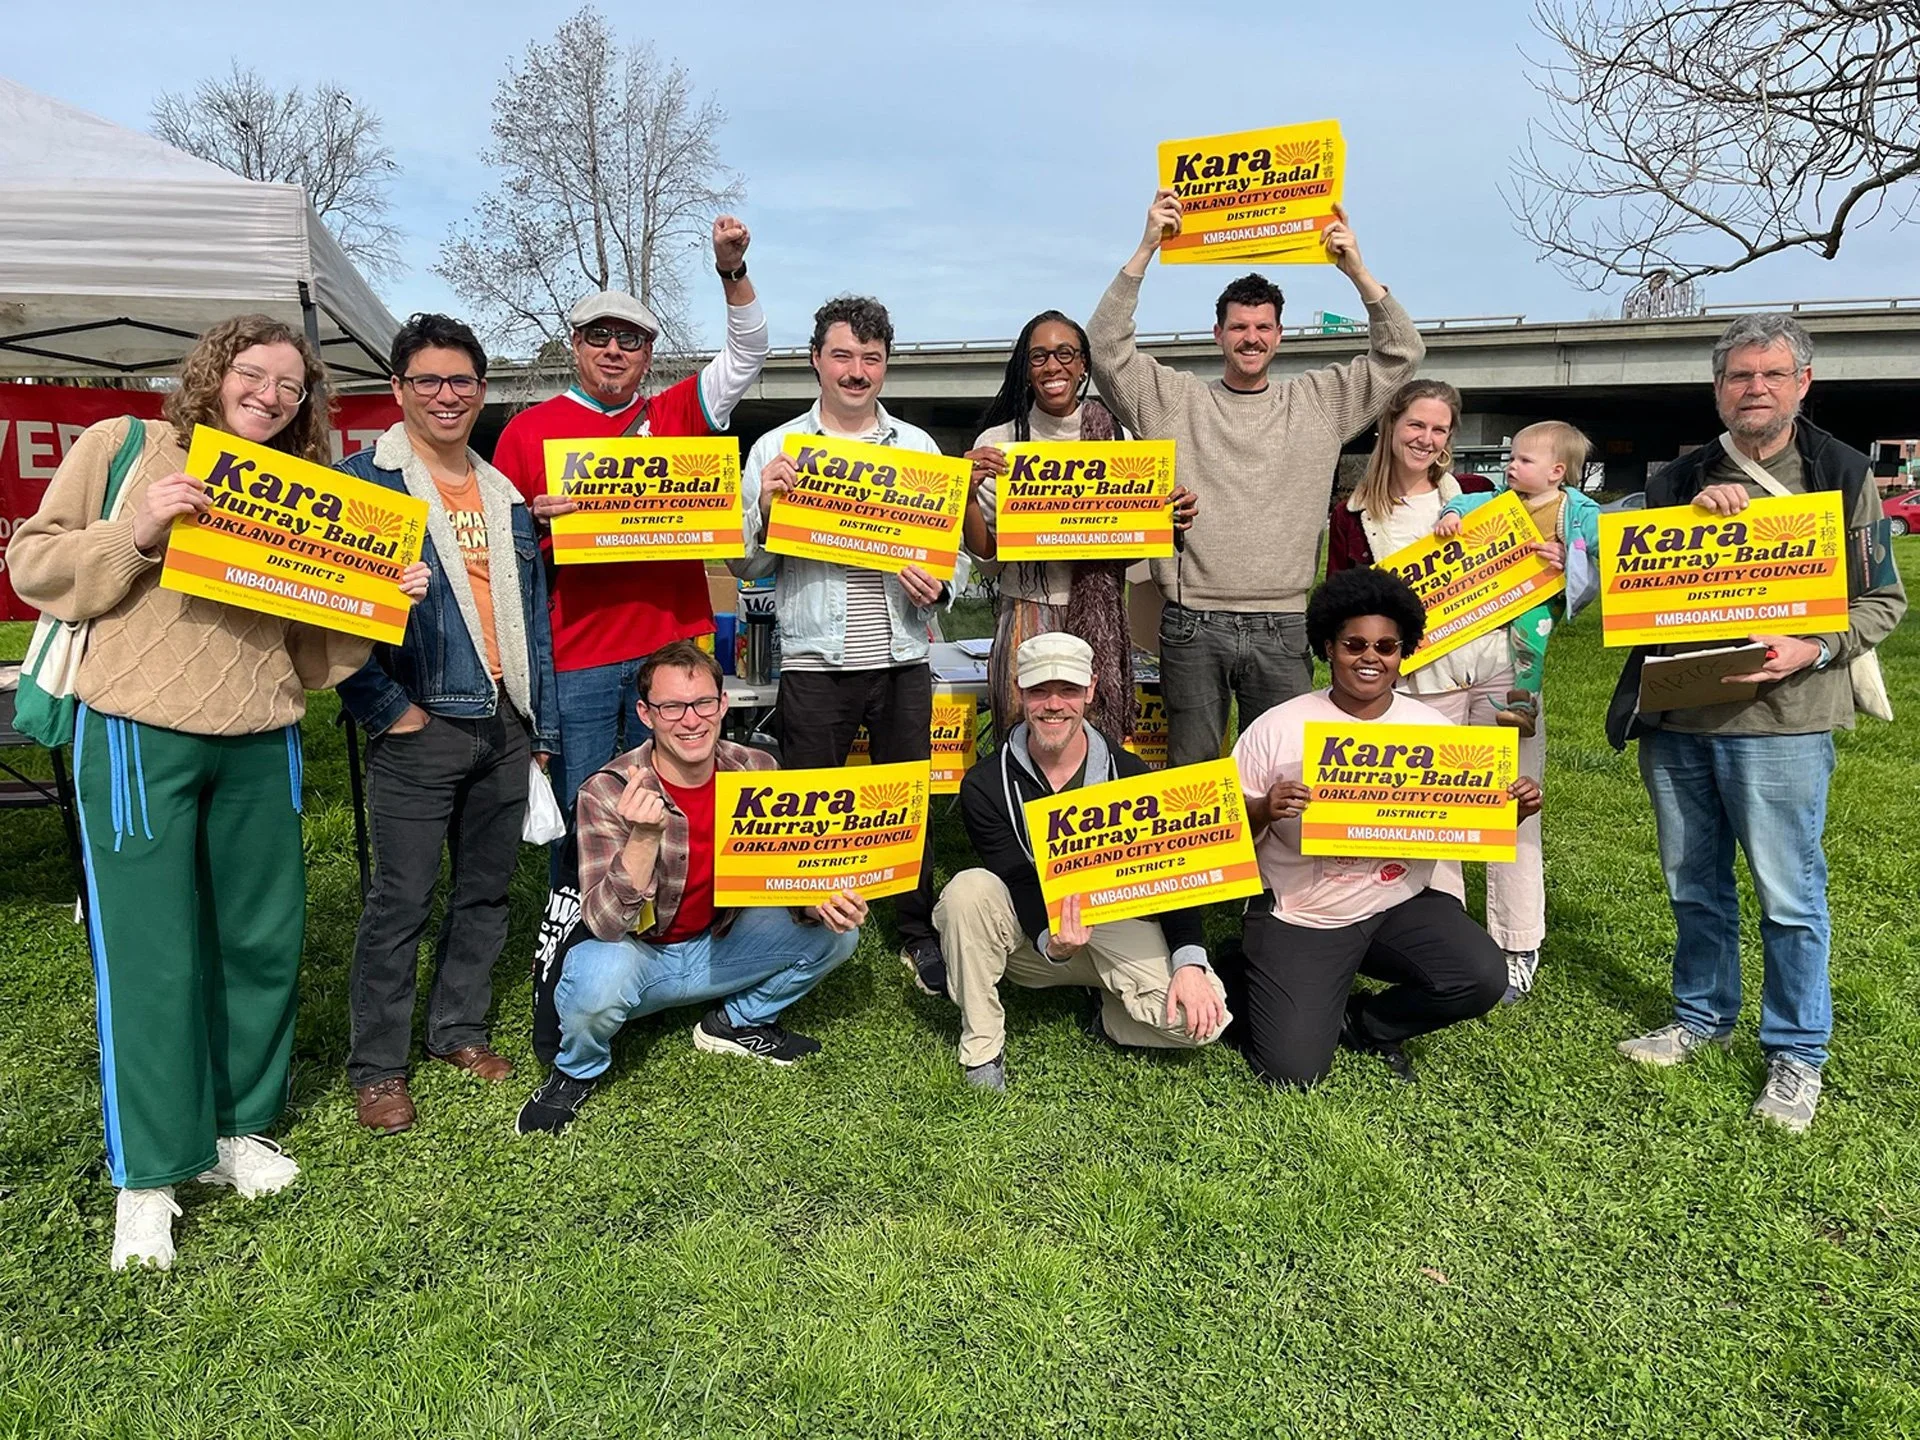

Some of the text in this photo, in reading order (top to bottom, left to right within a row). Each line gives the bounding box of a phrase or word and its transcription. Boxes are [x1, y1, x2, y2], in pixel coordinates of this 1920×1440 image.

[1172, 149, 1272, 184] Kara
[1174, 163, 1320, 197] Murray-Badal
[1181, 184, 1327, 212] AKLAND CITY COUNCIL
[1227, 206, 1286, 221] DISTRICT 2
[1203, 221, 1301, 245] KMB4OAKLAND.COM
[561, 452, 669, 480] Kara
[796, 446, 897, 488] Kara
[1009, 455, 1107, 482] Kara
[205, 452, 343, 522] Kara
[561, 477, 720, 498] Murray-Badal
[1009, 479, 1155, 499] Murray-Badal
[576, 498, 728, 511] AKLAND CITY COUNCIL
[788, 494, 948, 529] OAKLAND CITY COUNCIL
[1011, 500, 1160, 511] OAKLAND CITY COUNCIL
[203, 486, 398, 559] Murray-Badal
[621, 516, 675, 525] DISTRICT
[839, 519, 901, 536] DISTRICT 2
[199, 513, 400, 580] OAKLAND CITY COUNCIL
[595, 532, 701, 546] KMB4OAKLAND.COM
[810, 532, 914, 559] KMB4OAKLAND.COM
[1037, 533, 1133, 544] KMB4OAKLAND.COM
[1616, 522, 1748, 557] Kara
[267, 555, 345, 583] DISTRICT 2
[1390, 541, 1466, 587] ara
[1616, 539, 1816, 573] Murray-Badal
[1447, 574, 1477, 596] CITY
[1620, 563, 1827, 590] OAKLAND CITY COUNCIL
[226, 567, 359, 614] KMB4OAKLAND.COM
[1443, 585, 1490, 615] DISTRICT
[1491, 581, 1499, 589] 2
[1688, 587, 1767, 601] DISTRICT 2
[1428, 588, 1523, 644] KMB4OAKLAND.COM
[1655, 604, 1789, 626] KMB4OAKLAND.COM
[1317, 737, 1434, 769] Kara
[1316, 767, 1493, 788] Murray-Badal
[731, 787, 856, 819] Kara
[1319, 789, 1501, 805] OAKLAND CITY COUNCIL
[730, 808, 907, 837] Murray-Badal
[1045, 796, 1161, 842] Kara
[1377, 809, 1447, 819] DISTRICT 2
[733, 829, 913, 853] OAKLAND CITY COUNCIL
[1048, 806, 1221, 859] Murray-Badal
[1347, 826, 1465, 843] KMB4OAKLAND.COM
[798, 855, 868, 868] DISTRICT 2
[1053, 829, 1234, 874] OAKLAND CITY COUNCIL
[1116, 857, 1185, 878] DISTRICT 2
[766, 873, 882, 891] KMB4OAKLAND.COM
[1090, 873, 1209, 905] KMB4OAKLAND.COM
